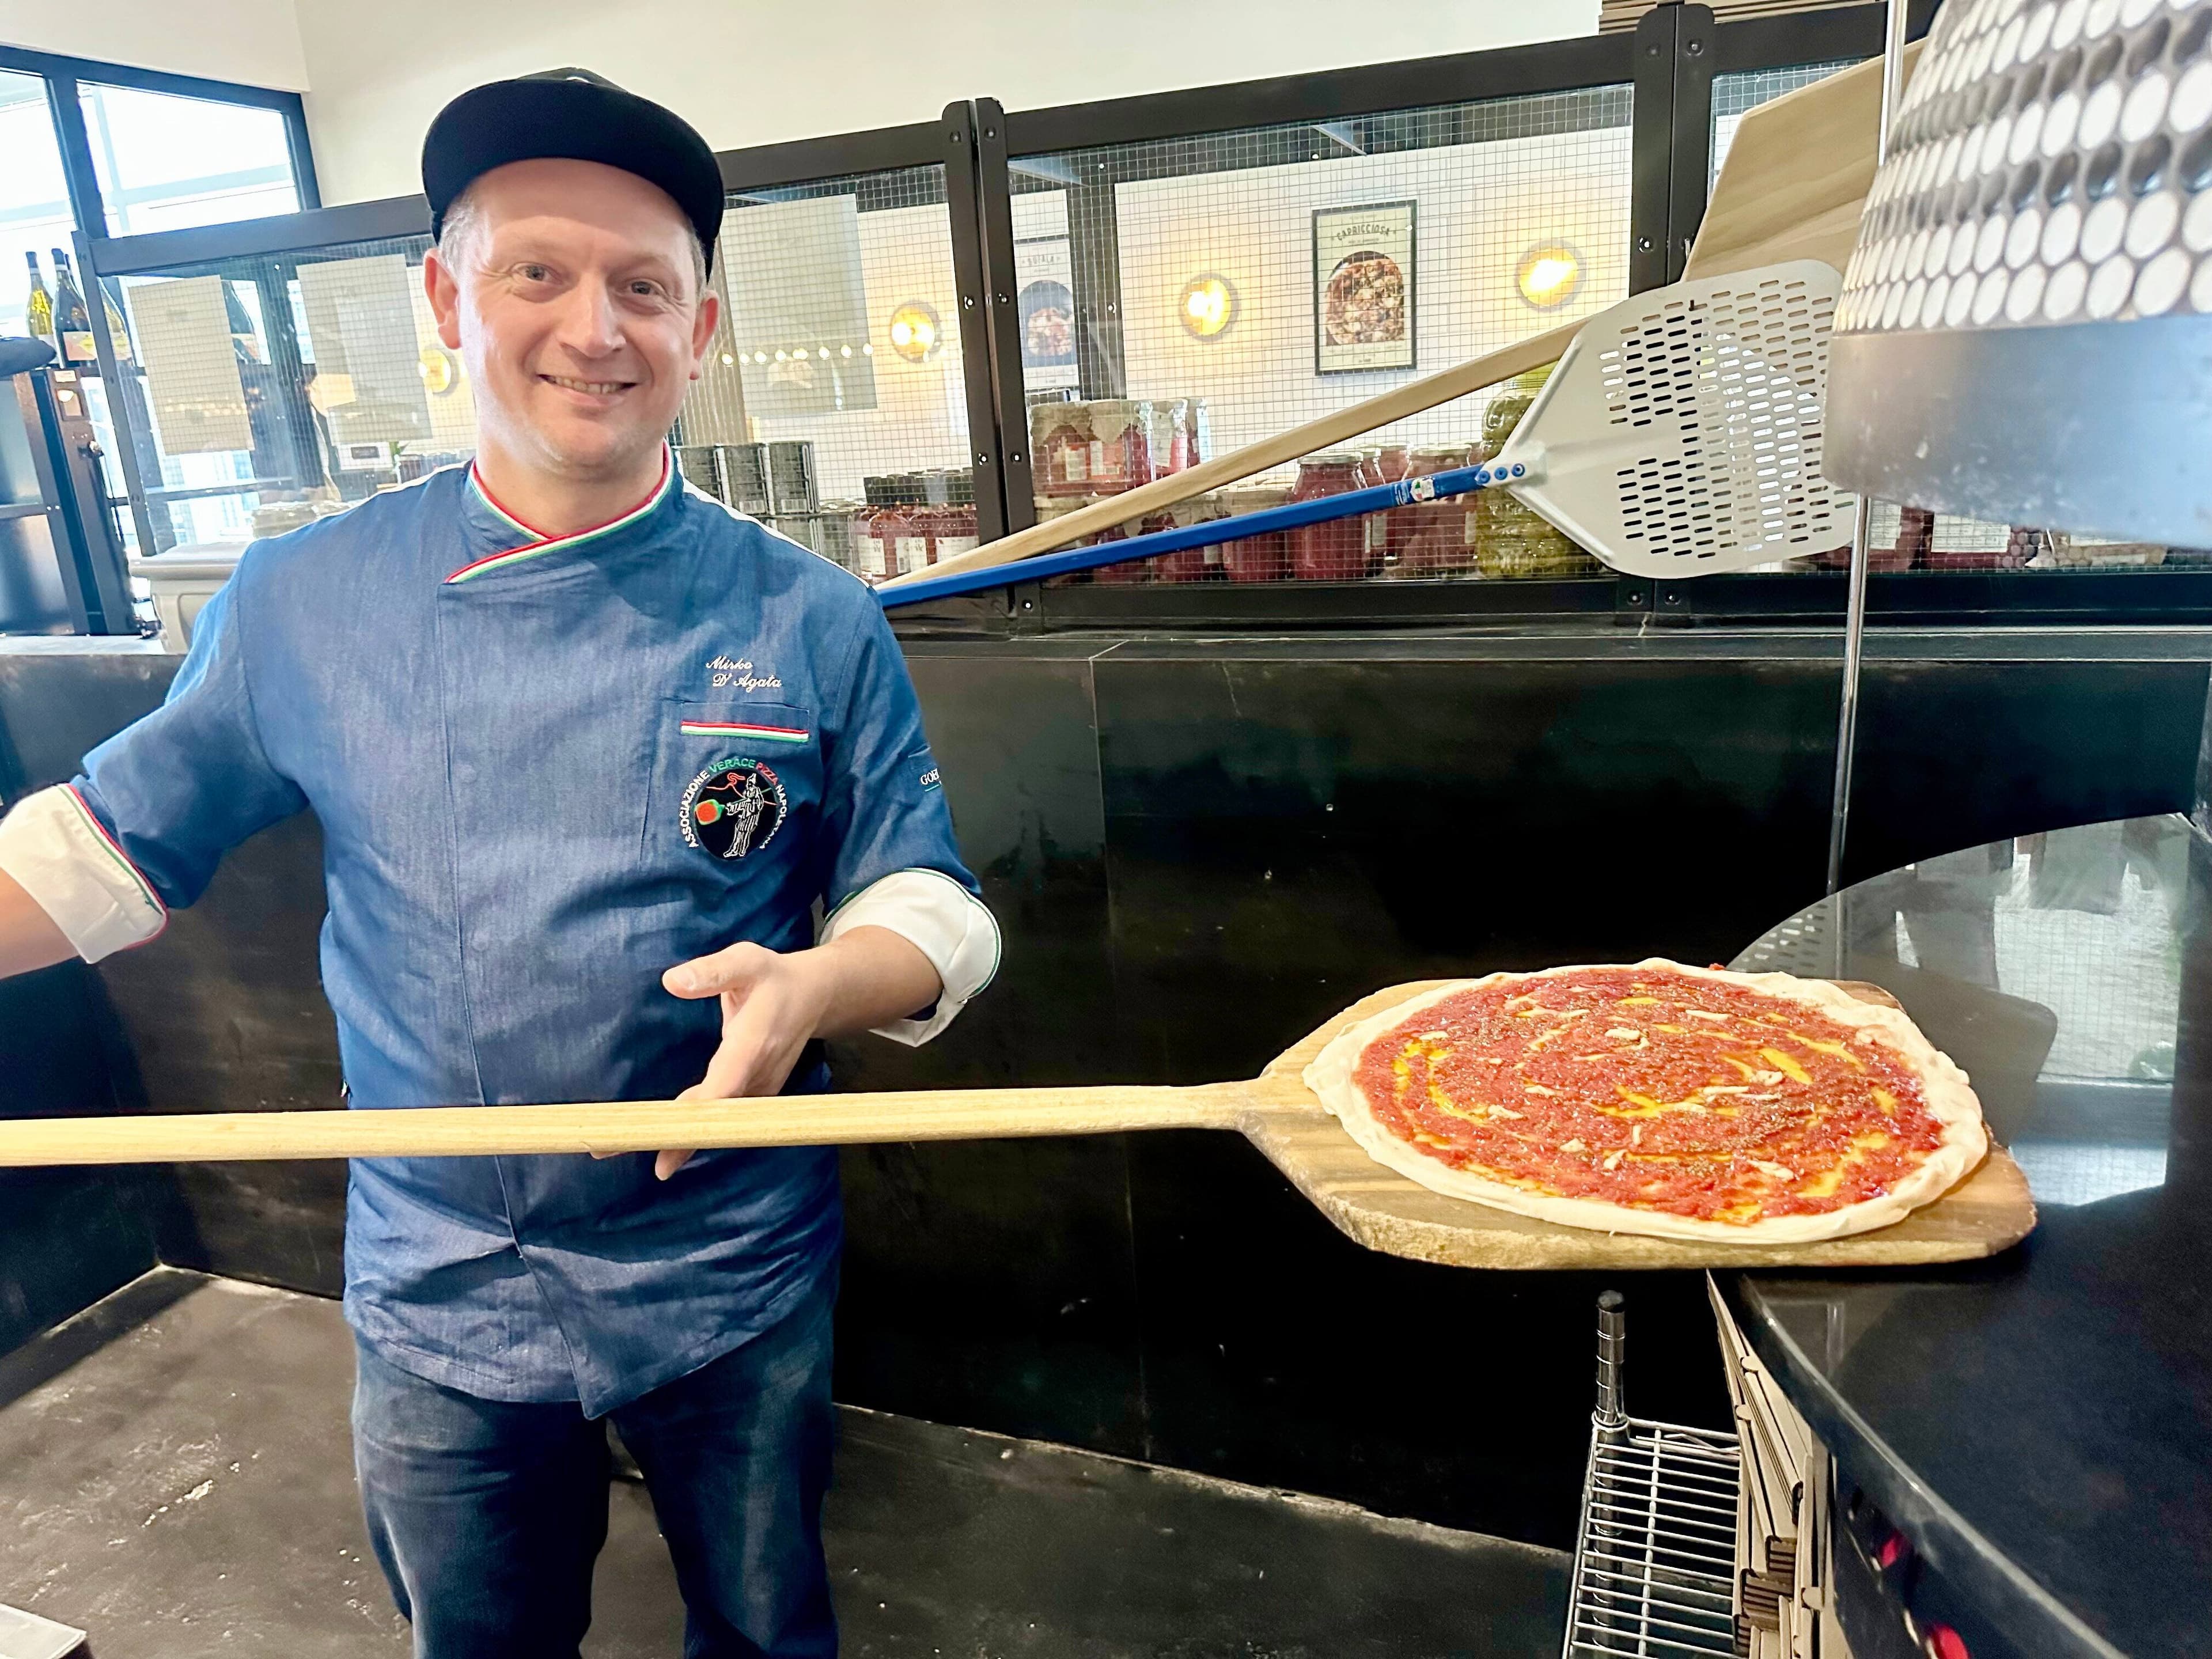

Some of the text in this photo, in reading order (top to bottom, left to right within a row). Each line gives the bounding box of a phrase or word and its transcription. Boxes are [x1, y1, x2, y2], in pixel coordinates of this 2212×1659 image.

[1336, 224, 1389, 241] CAPRICCIOSA
[706, 655, 753, 669] Mirko
[733, 672, 782, 693] Agata
[679, 770, 710, 848] ASSOCIAZIONE
[709, 757, 756, 773] VERACE
[755, 762, 779, 786] PIZZA
